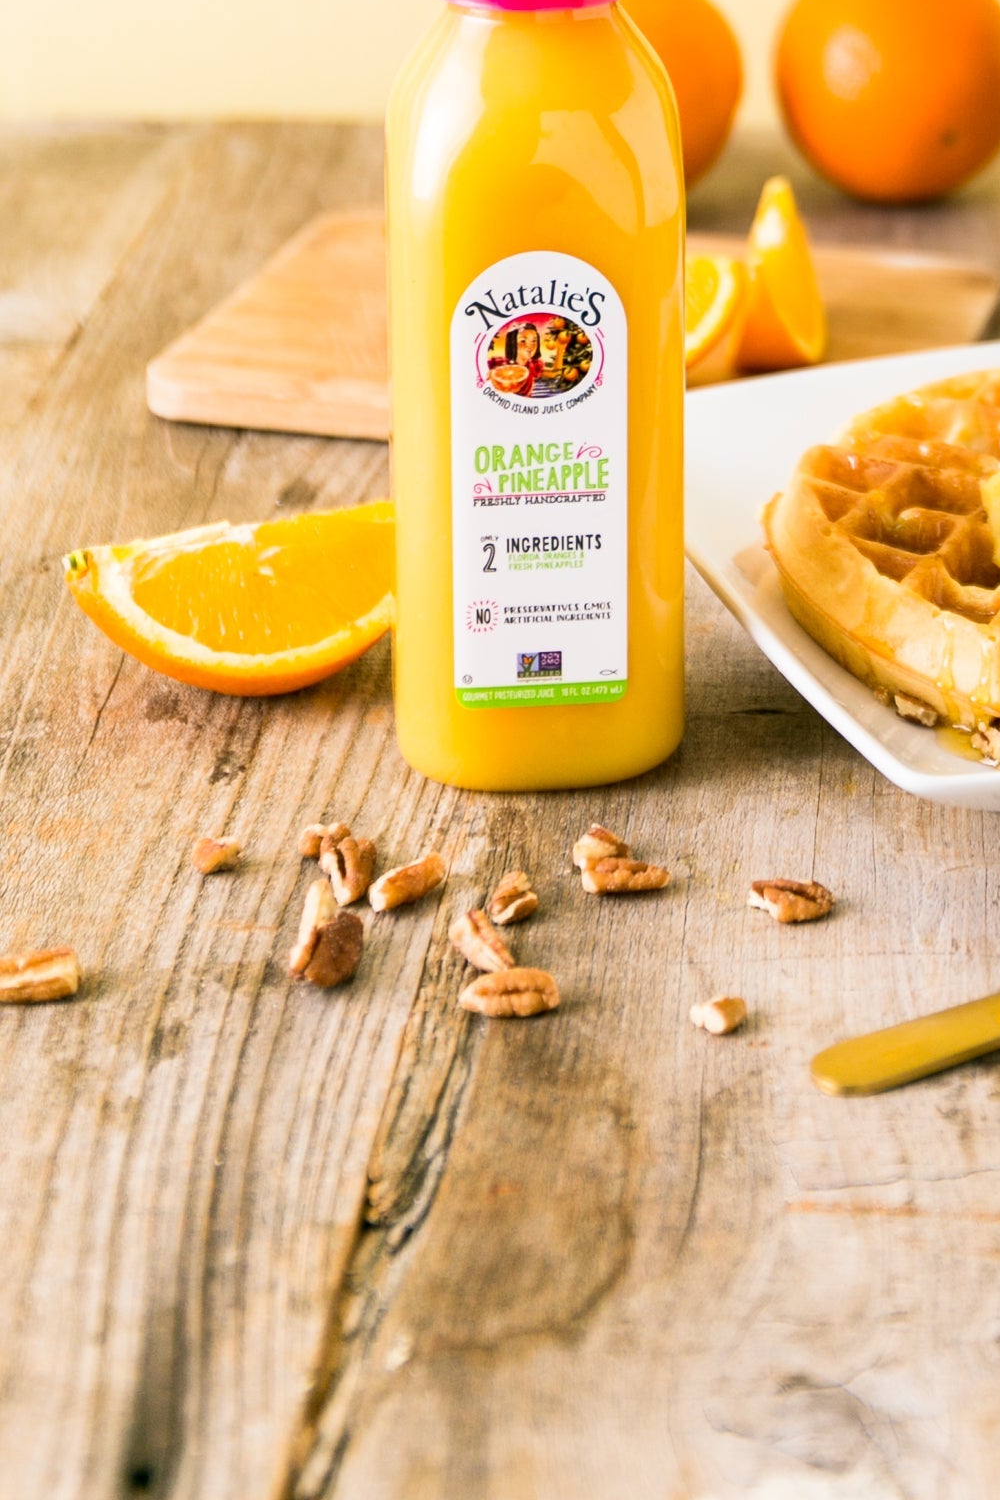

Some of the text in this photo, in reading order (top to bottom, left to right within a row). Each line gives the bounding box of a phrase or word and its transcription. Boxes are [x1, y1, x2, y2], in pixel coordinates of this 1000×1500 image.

[483, 383, 597, 415] ORCHID ISLAND JUICE COMPANY
[474, 442, 573, 474] ORANGE
[498, 458, 609, 493] PINEAPPLE
[473, 493, 606, 507] FRESHLY HANDCRAFTED
[506, 534, 602, 553] INGREDIENTS
[483, 543, 497, 572] 2
[476, 608, 491, 625] NO
[504, 612, 611, 624] ARTIFICIAL INGREDIENTS
